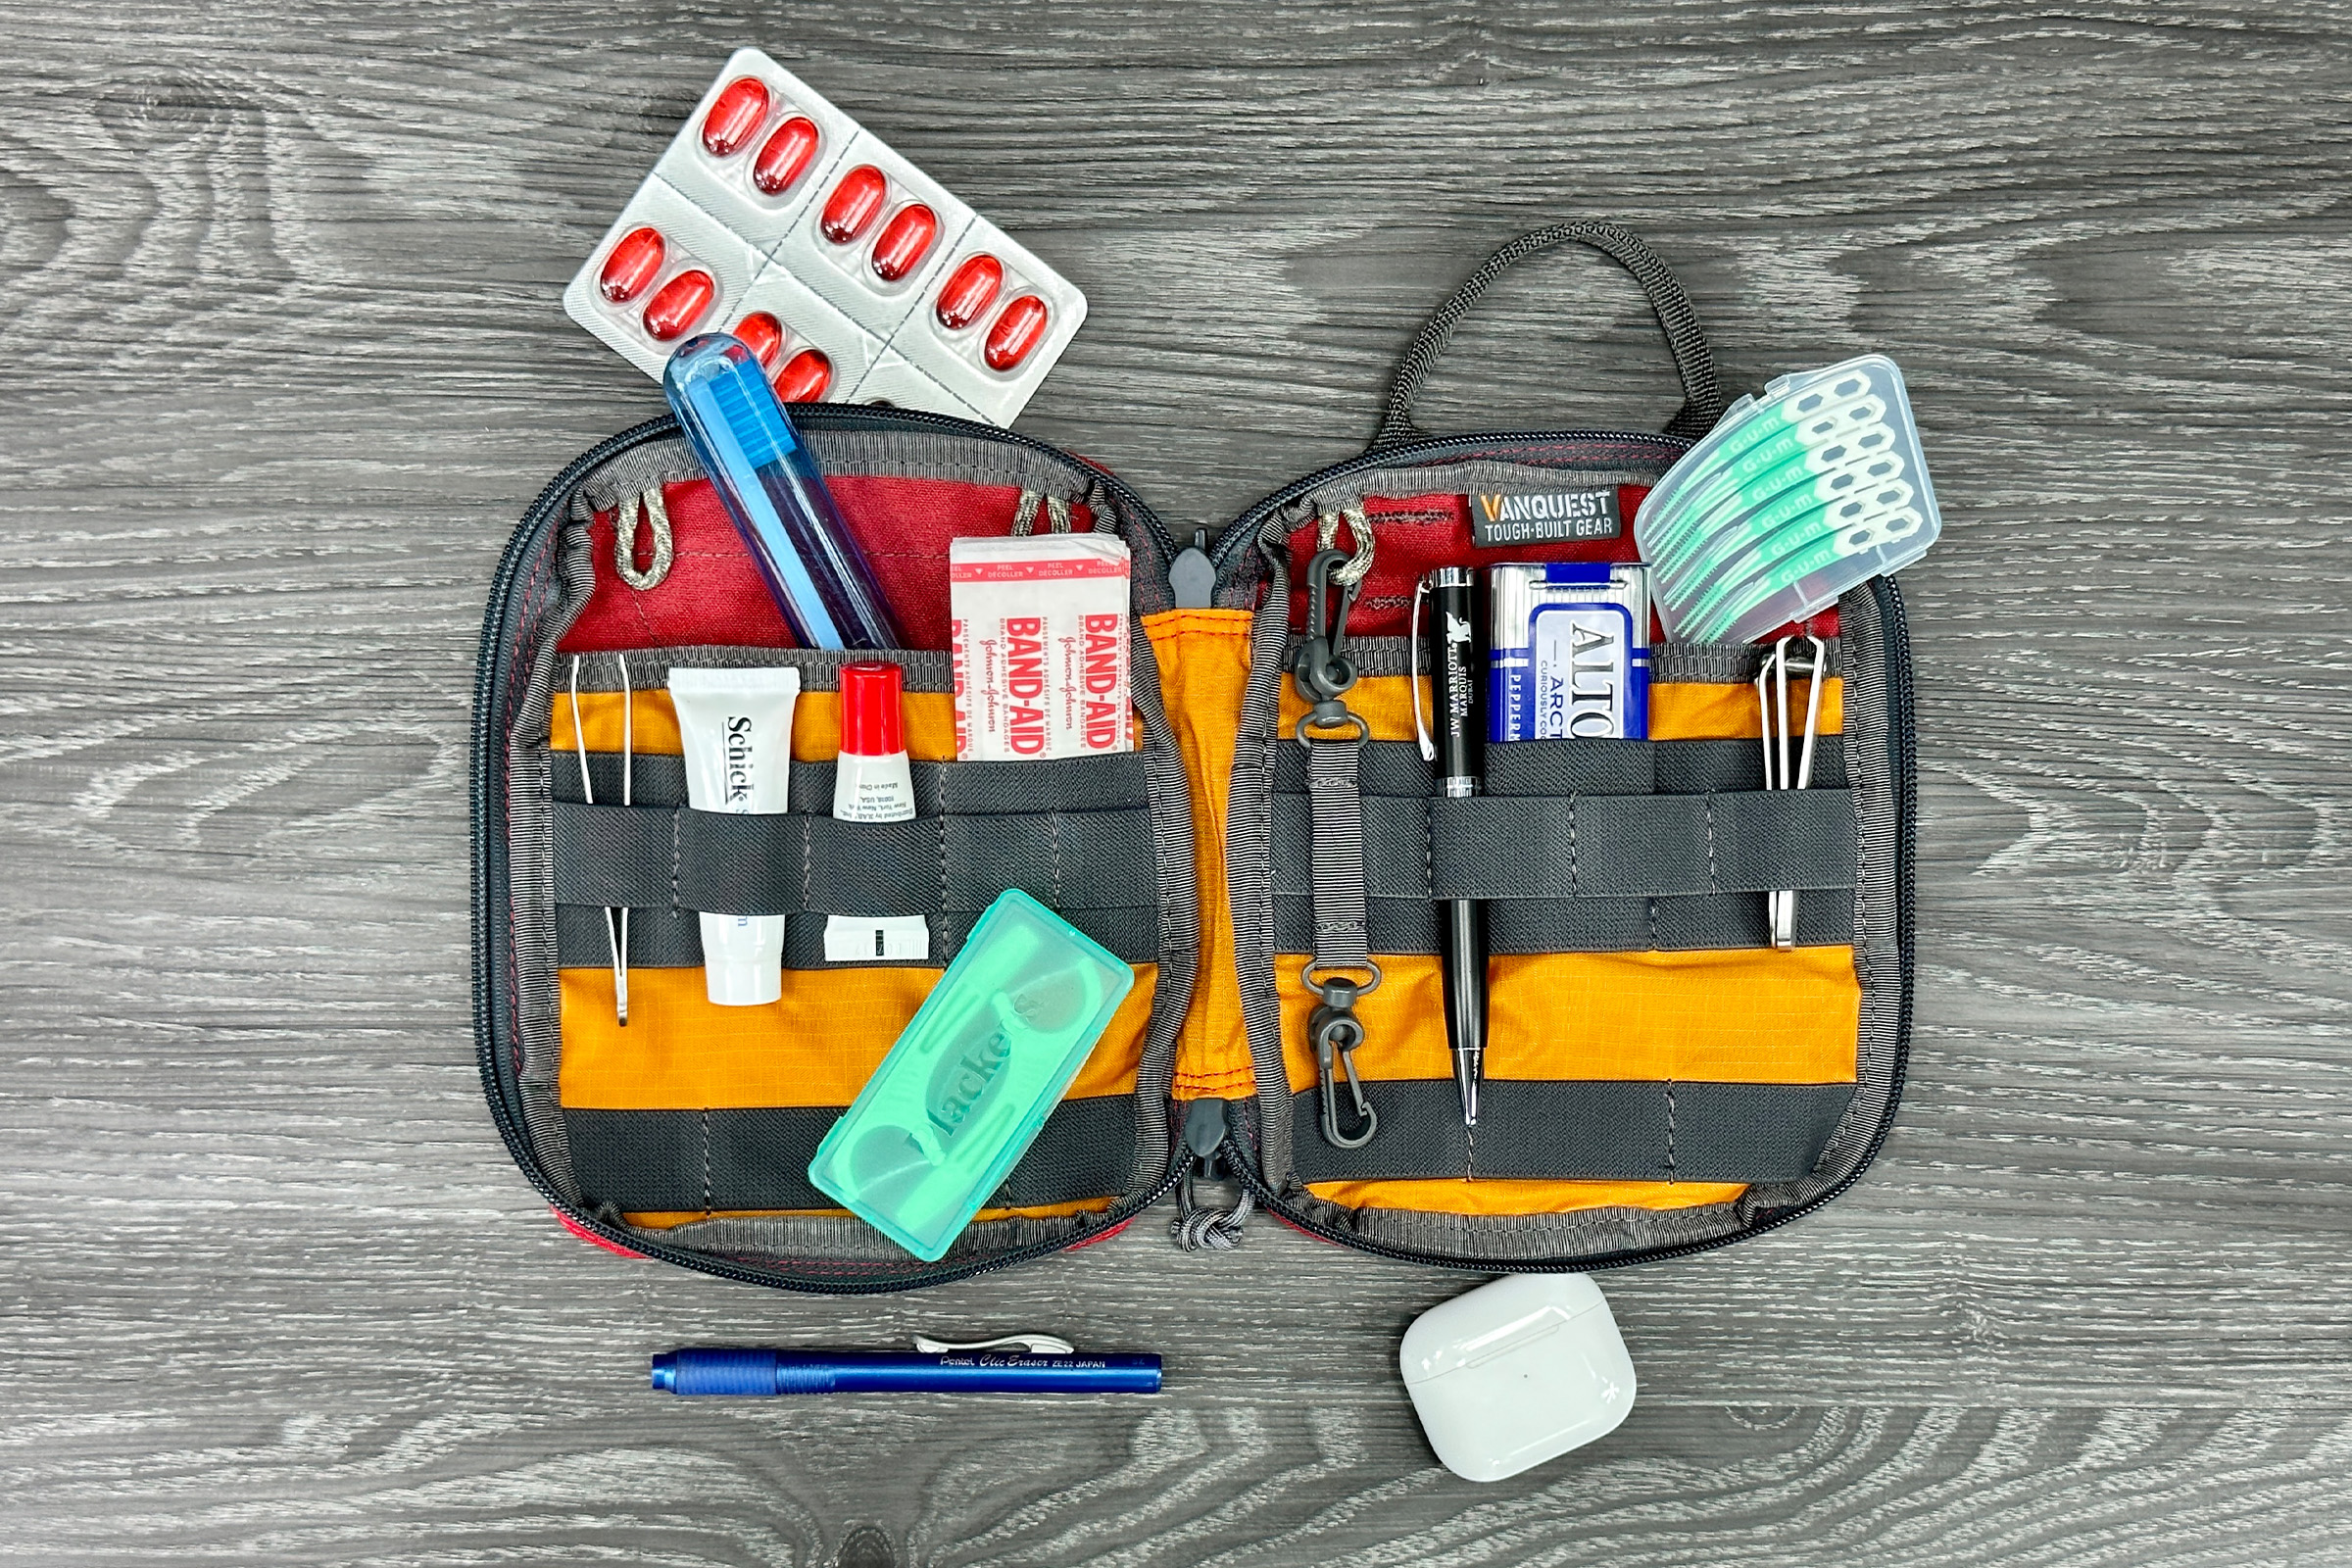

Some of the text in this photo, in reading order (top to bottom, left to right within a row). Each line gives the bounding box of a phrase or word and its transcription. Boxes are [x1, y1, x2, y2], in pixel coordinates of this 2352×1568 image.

[1480, 490, 1610, 521] VANQUEST
[1576, 517, 1612, 536] GEAR
[1447, 647, 1460, 738] JW MARRIOTT
[1458, 665, 1468, 717] MARQUIS
[1540, 660, 1548, 719] CURIOUSLY
[727, 716, 755, 802] Schick
[940, 1355, 975, 1366] Pentel
[979, 1353, 1004, 1367] Clic
[1006, 1354, 1048, 1367] Eraser
